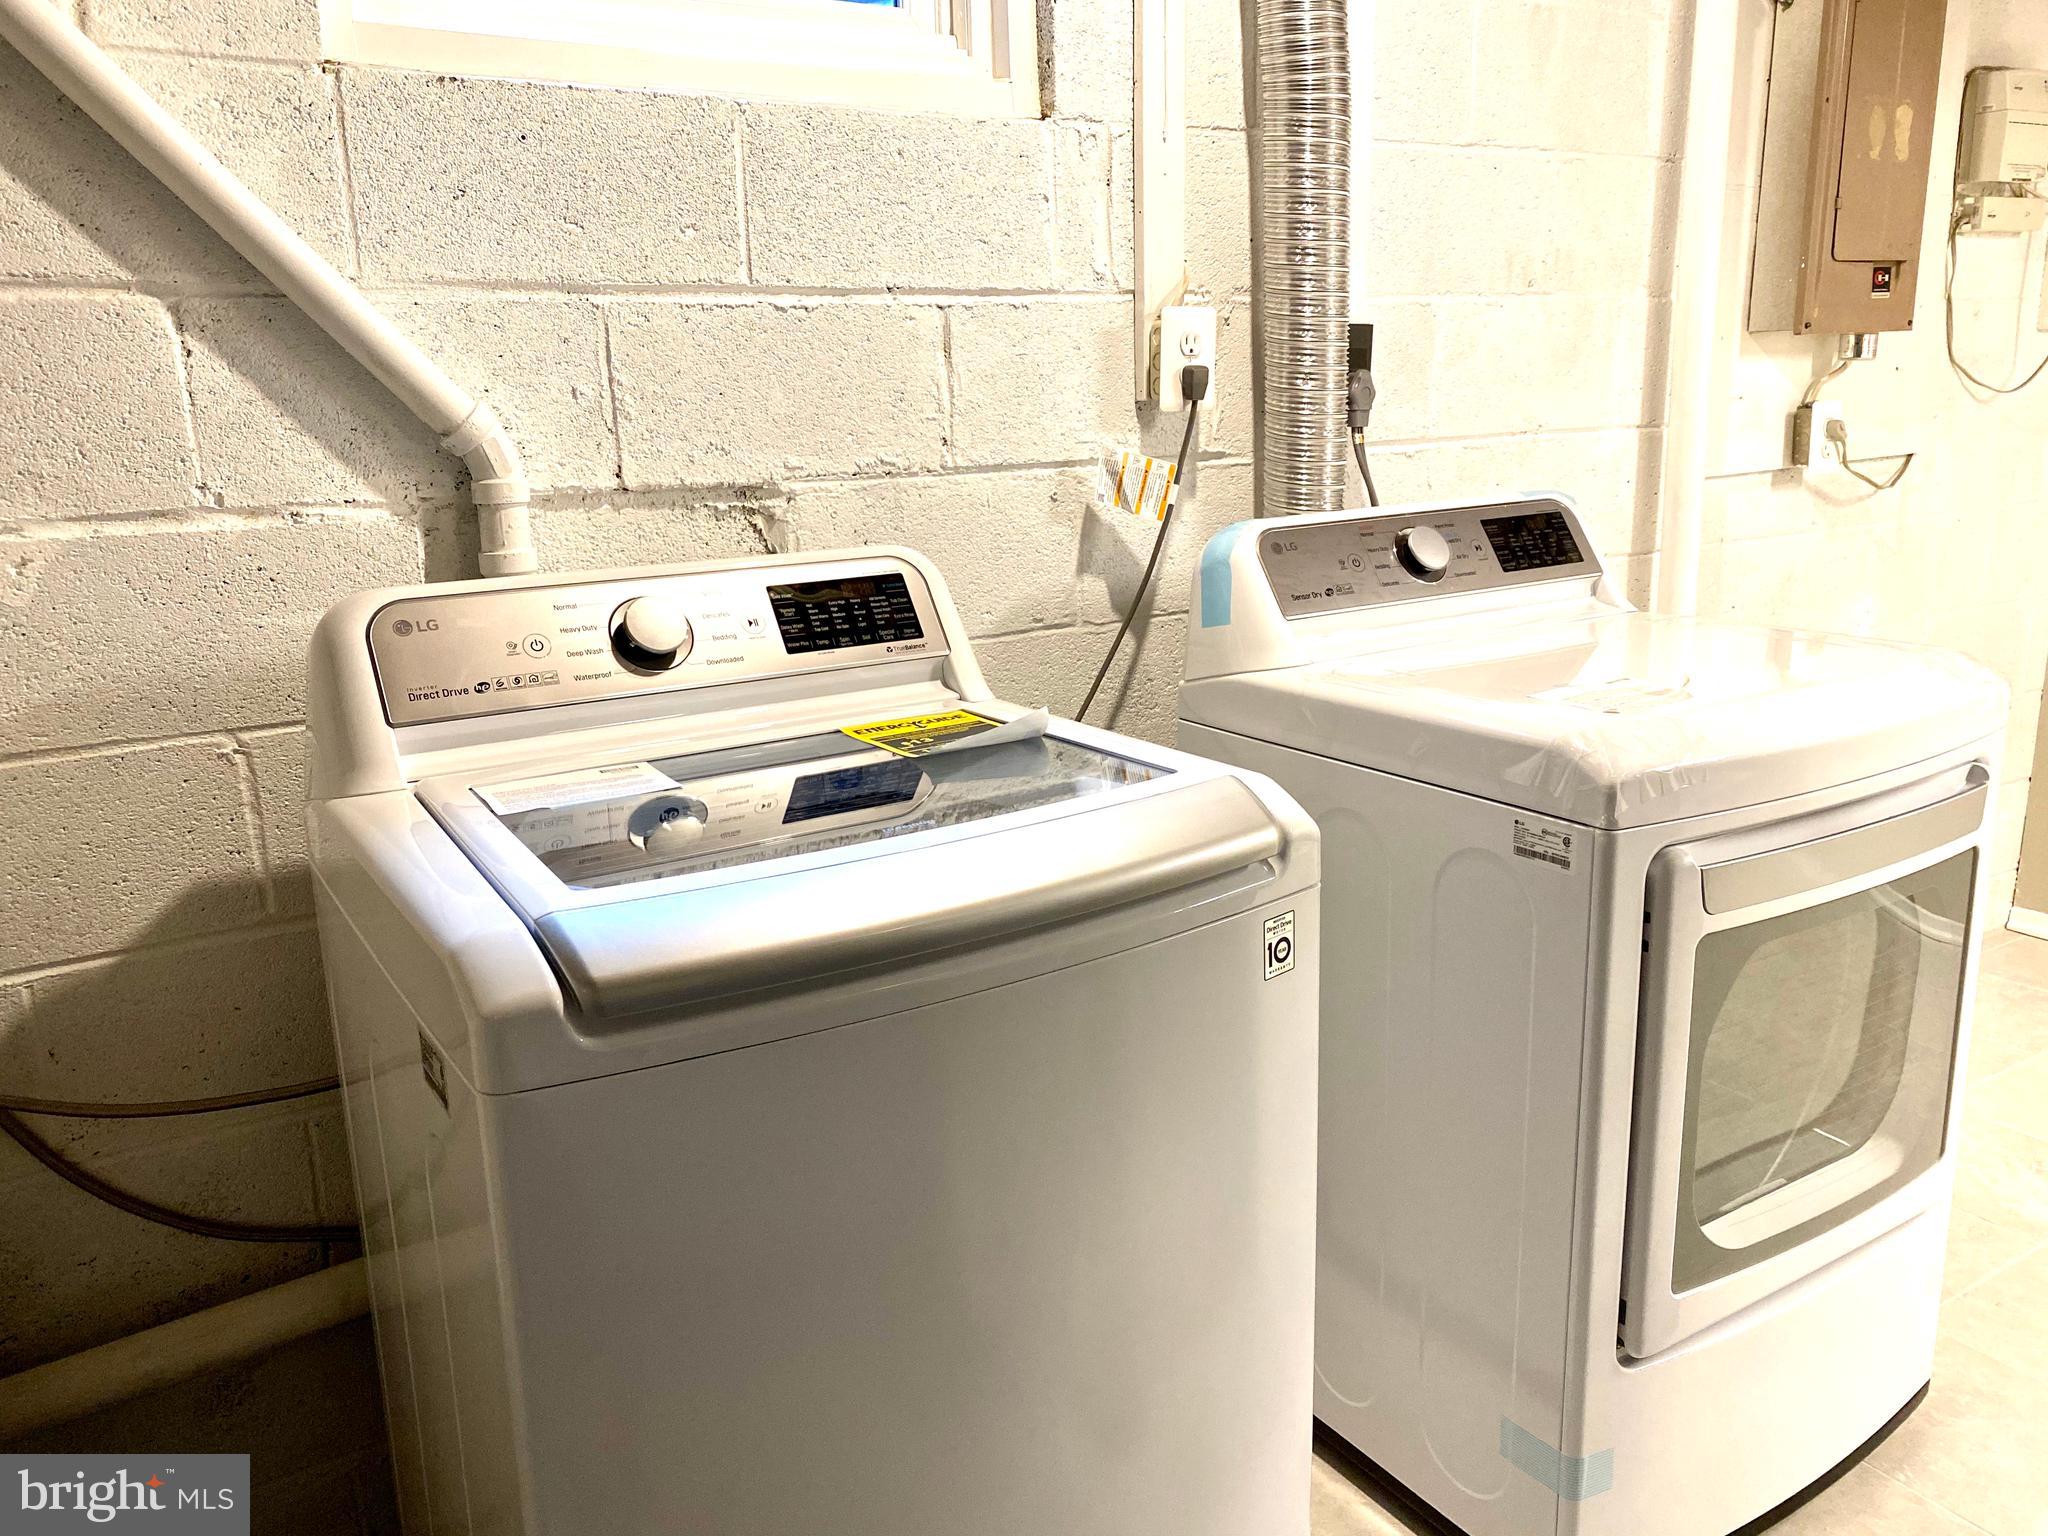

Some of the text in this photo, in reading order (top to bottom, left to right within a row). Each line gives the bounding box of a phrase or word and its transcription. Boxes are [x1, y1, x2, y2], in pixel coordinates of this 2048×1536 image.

[1284, 542, 1298, 552] LG
[1290, 591, 1323, 602] Sensor Dry
[553, 603, 578, 611] Normal
[415, 619, 440, 633] LG
[581, 624, 598, 632] Duty
[566, 647, 604, 658] Deep Wash
[706, 656, 745, 666] Downloaded
[573, 671, 612, 682] Waterproof
[406, 685, 438, 693] Inverter
[407, 687, 470, 702] Direct Drive
[1266, 919, 1292, 934] Direct Drive
[1267, 936, 1292, 969] 10
